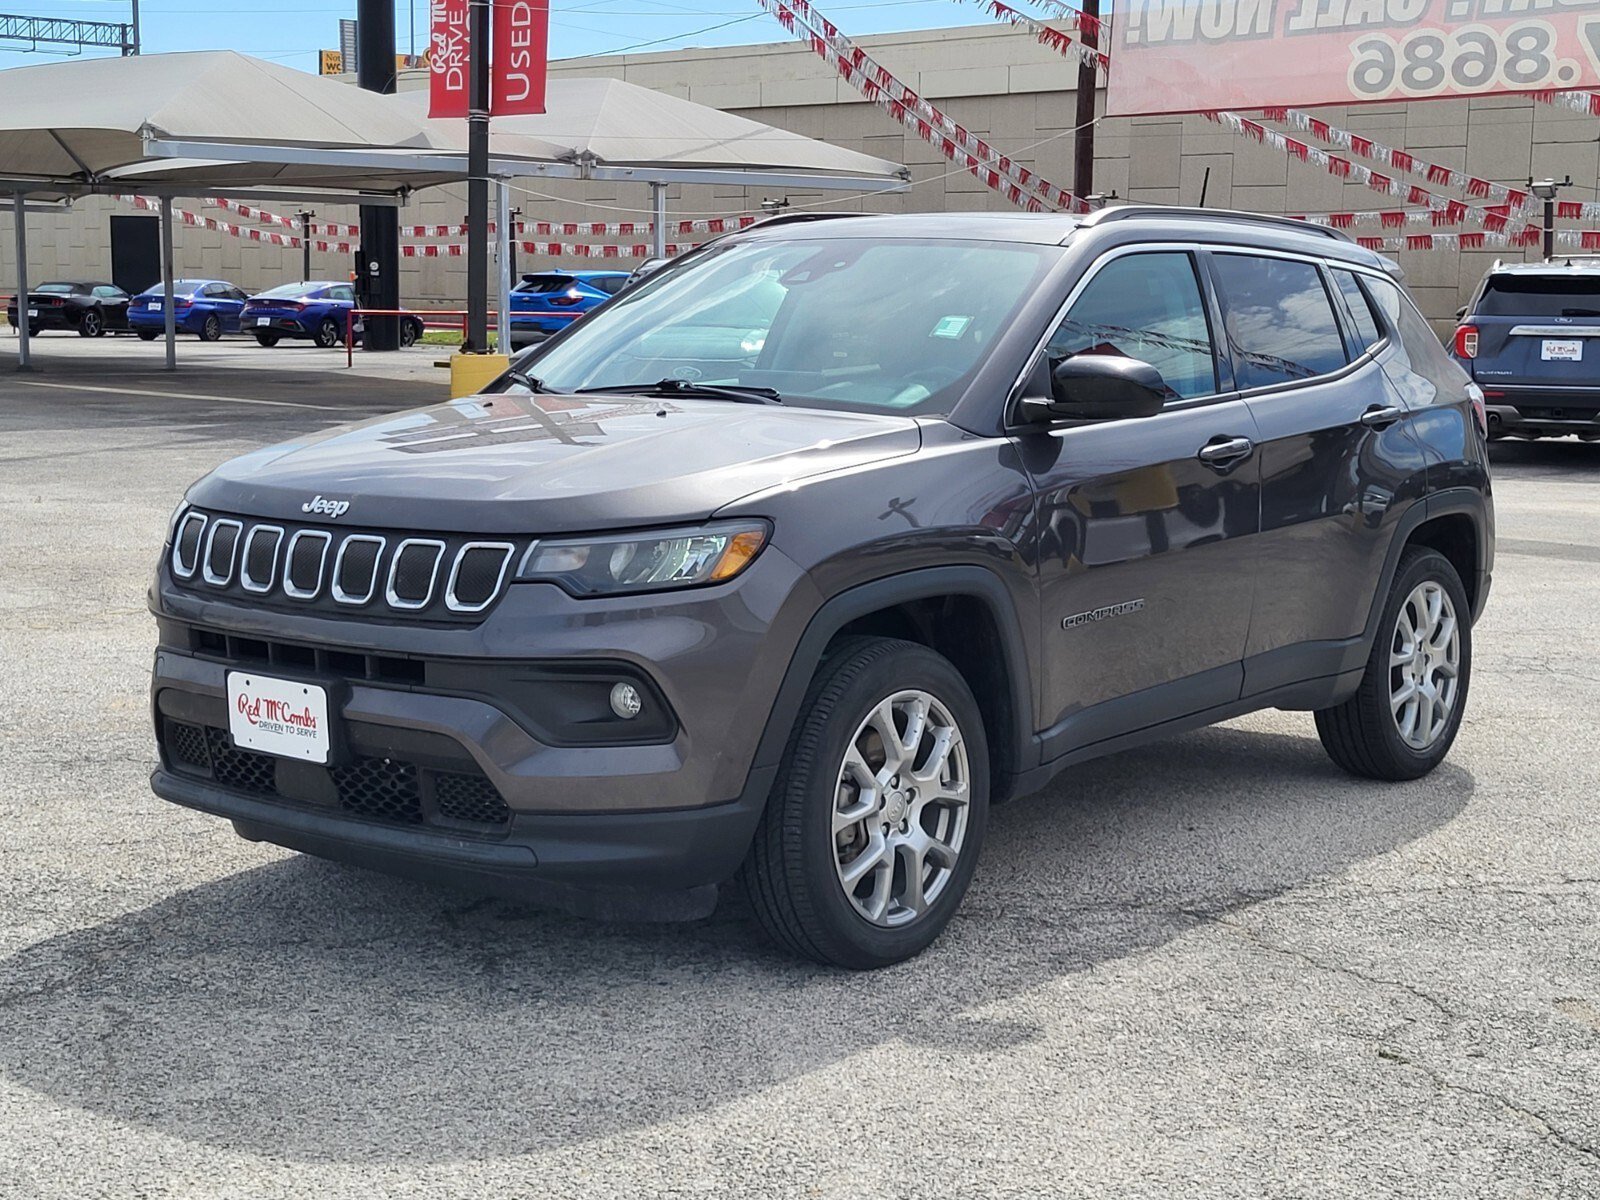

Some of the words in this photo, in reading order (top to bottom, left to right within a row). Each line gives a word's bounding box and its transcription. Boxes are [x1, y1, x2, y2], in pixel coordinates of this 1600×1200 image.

[430, 32, 451, 74] Red
[506, 1, 531, 102] USED
[301, 495, 350, 519] Jeep
[1061, 598, 1145, 630] COMPASS
[237, 693, 261, 725] Red
[262, 697, 318, 729] McCombs
[258, 720, 284, 732] DRIVEN
[285, 725, 295, 734] TO
[296, 727, 317, 739] SERVE
